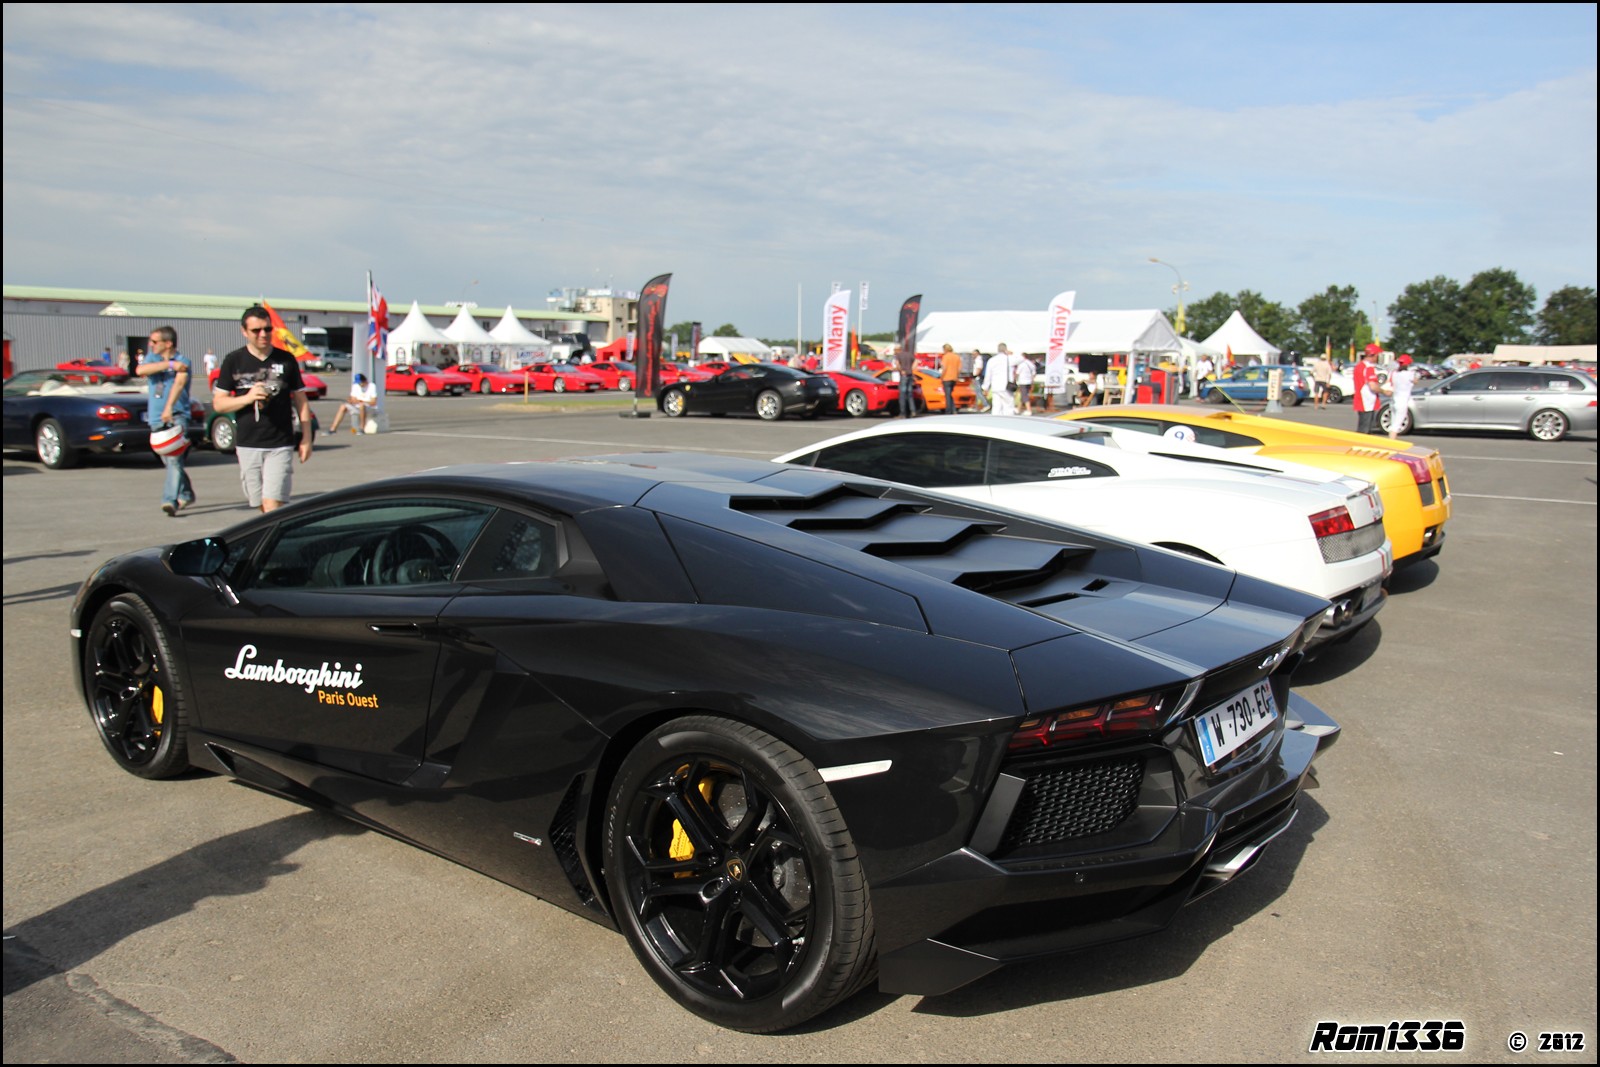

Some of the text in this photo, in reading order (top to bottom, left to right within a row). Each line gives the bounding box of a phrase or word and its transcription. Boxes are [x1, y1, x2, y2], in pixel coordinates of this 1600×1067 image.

[828, 304, 848, 351] Many
[1049, 304, 1071, 351] Many
[224, 644, 364, 694] Lamborghini
[317, 689, 380, 709] Paris Ouest
